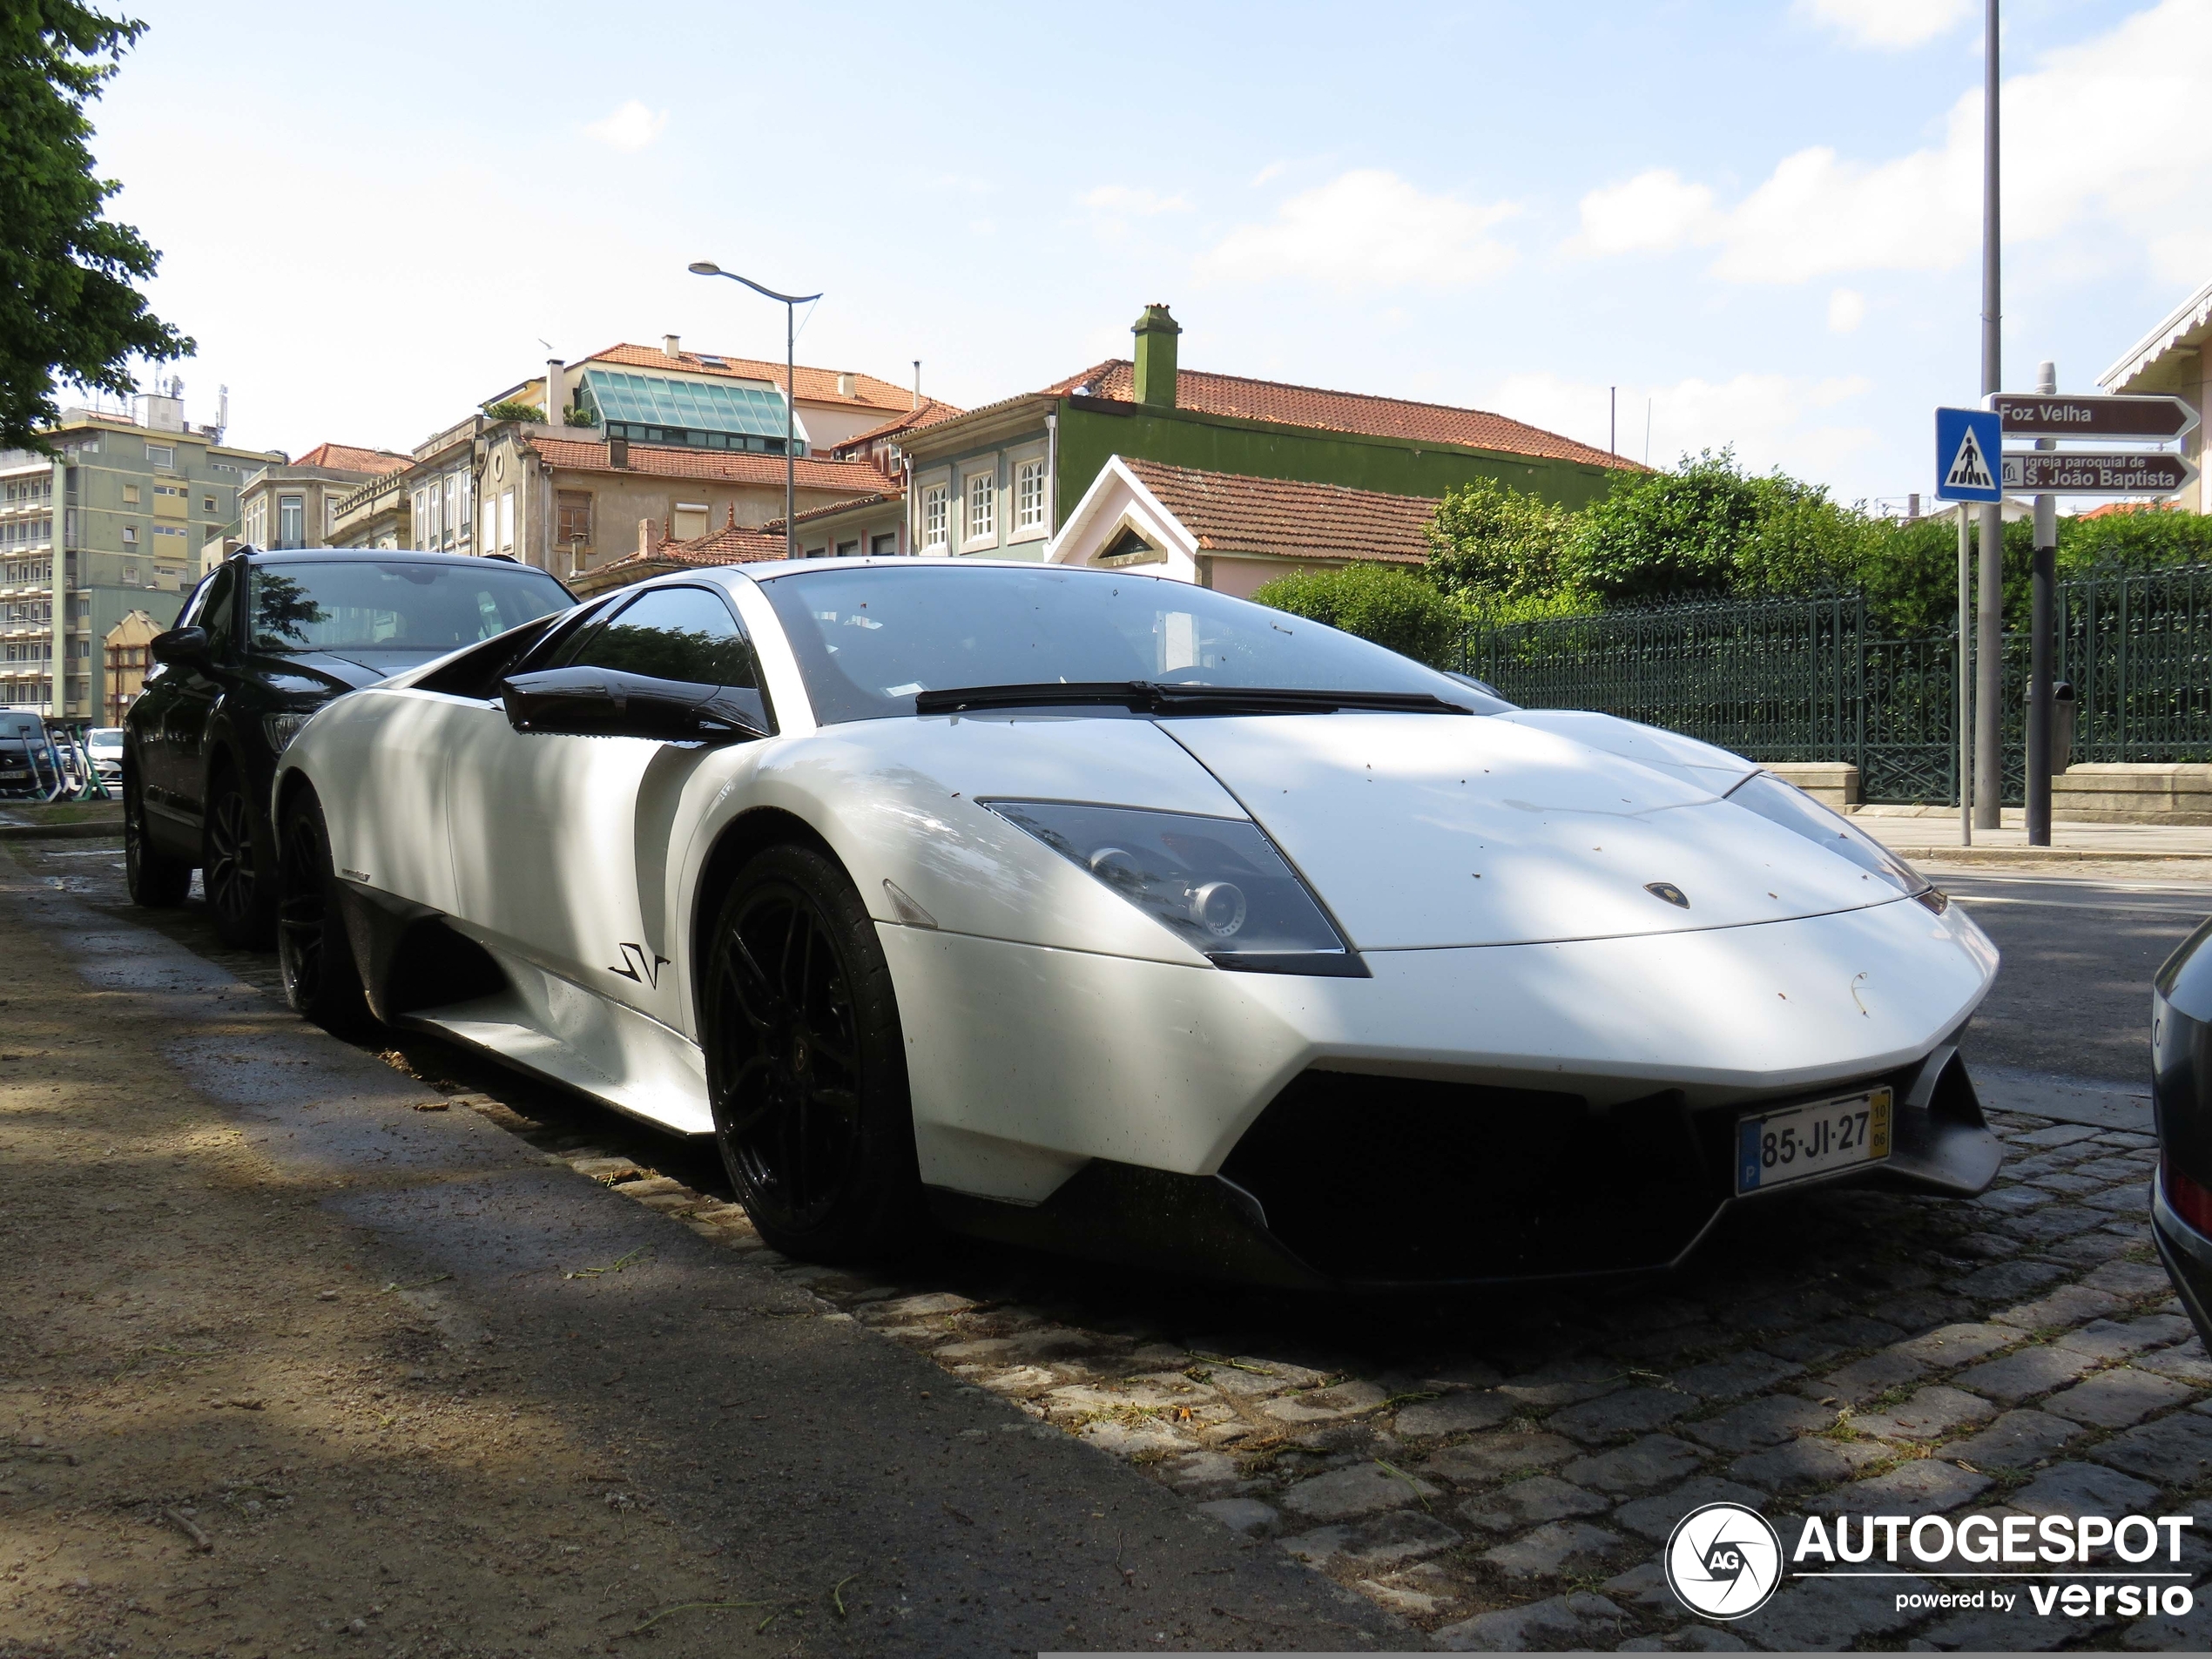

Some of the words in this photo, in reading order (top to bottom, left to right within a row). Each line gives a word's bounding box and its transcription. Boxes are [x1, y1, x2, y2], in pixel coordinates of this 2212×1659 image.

[2000, 403, 2034, 421] Foz
[2039, 404, 2092, 422] Velha
[2025, 455, 2061, 470] igreja
[2065, 455, 2126, 470] paroquial
[2129, 455, 2146, 468] de
[2025, 469, 2043, 486] S.
[2048, 469, 2094, 486] João
[2100, 469, 2175, 489] Baptista
[1874, 1103, 1887, 1119] 10
[1873, 1132, 1886, 1148] 06
[1745, 1164, 1757, 1184] P
